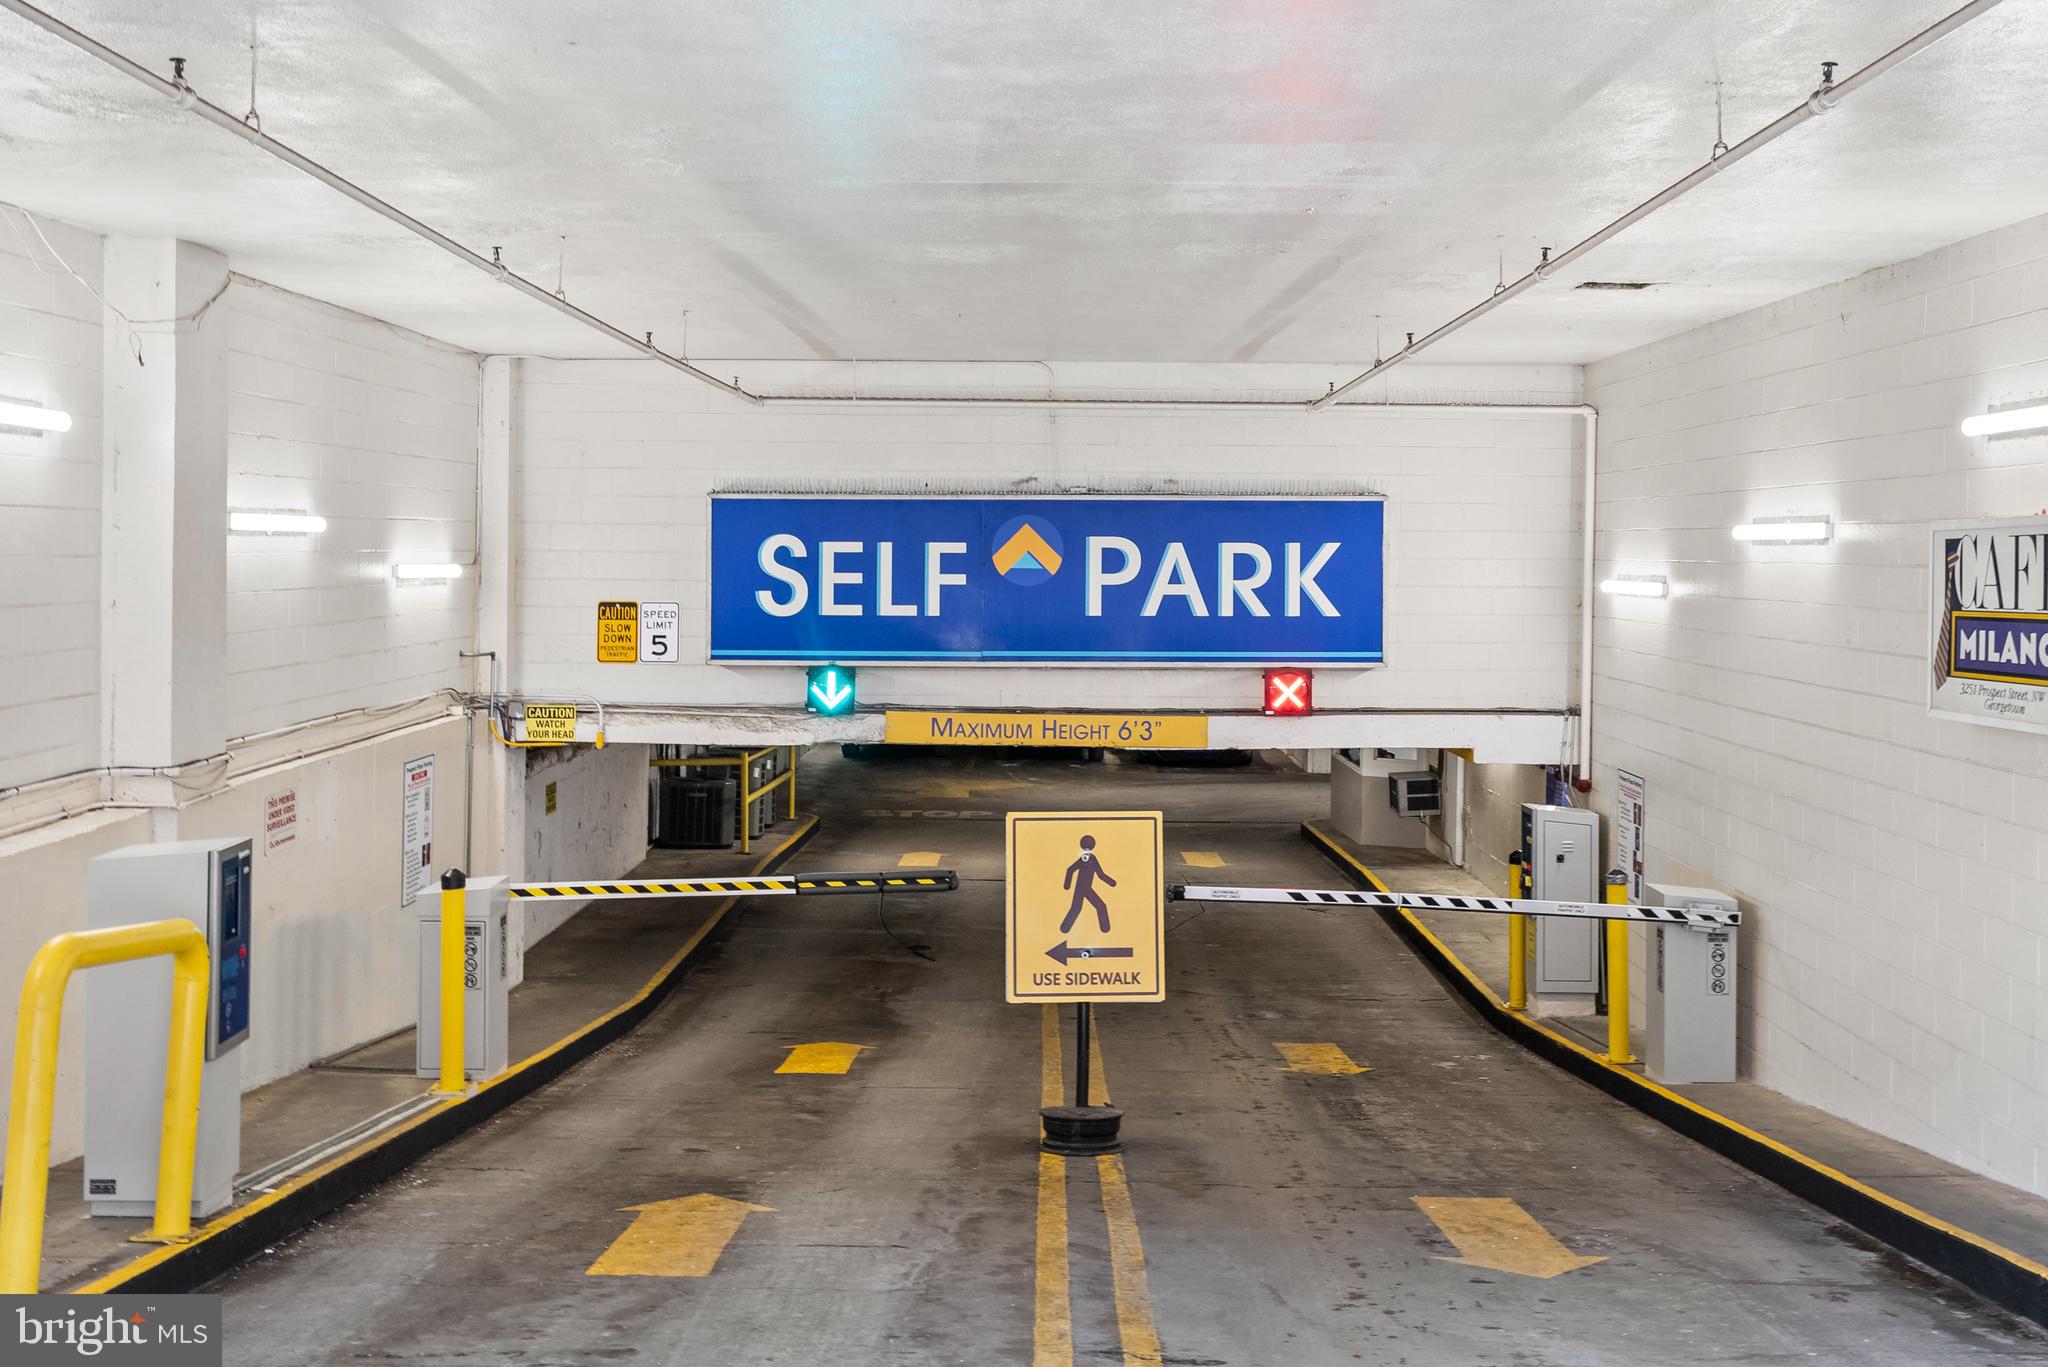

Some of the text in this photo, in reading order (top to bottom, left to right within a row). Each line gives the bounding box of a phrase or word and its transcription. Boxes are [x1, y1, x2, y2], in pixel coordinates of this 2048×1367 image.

[755, 533, 1342, 618] SELF PARK
[599, 605, 637, 620] CAUTION
[643, 610, 677, 619] SPEED
[604, 623, 632, 633] SLOW
[646, 621, 673, 630] LIMIT
[603, 634, 632, 643] DOWN
[651, 634, 668, 657] 5
[1960, 682, 1977, 696] 3251
[1978, 684, 2006, 698] Prospect
[1984, 697, 2026, 715] Georgetown
[528, 707, 574, 719] CAUTION
[535, 720, 566, 729] WATCH
[931, 717, 1162, 741] MAXIMUM HEIGHT 6'3"
[526, 729, 575, 739] YOUR HEAD
[1032, 971, 1142, 986] USE SIDEWALK
